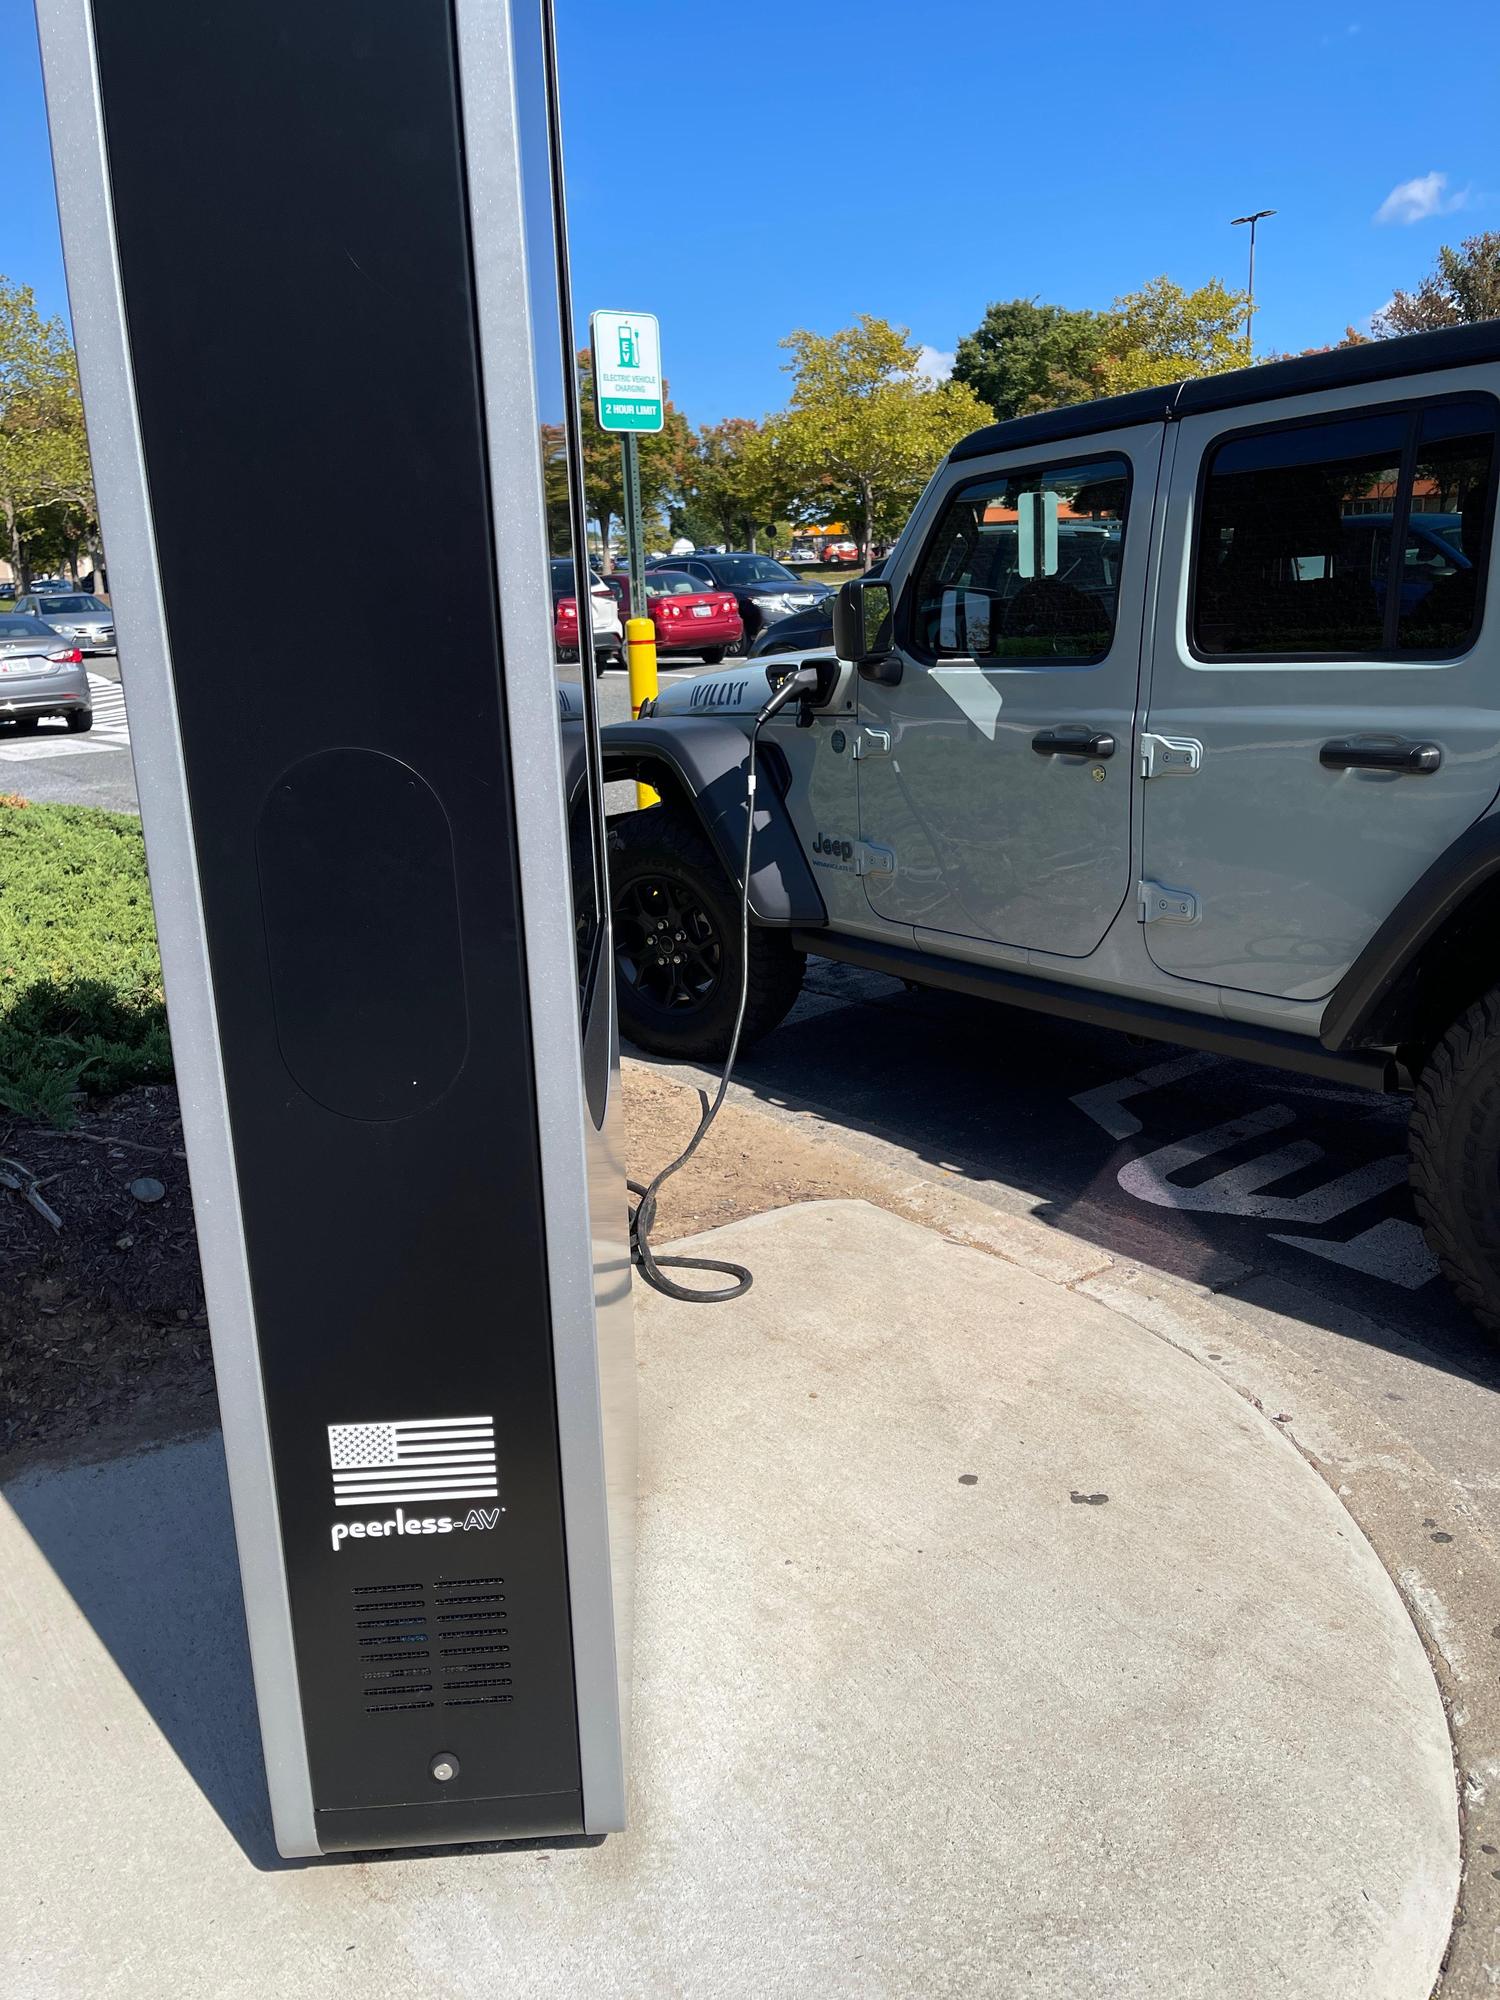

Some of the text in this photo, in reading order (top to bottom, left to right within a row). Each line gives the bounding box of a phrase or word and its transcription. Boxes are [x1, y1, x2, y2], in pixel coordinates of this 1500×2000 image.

[603, 373, 656, 384] ELECTRIC VEHICLE
[615, 384, 646, 393] CHARGING
[605, 404, 657, 416] 2 HOUR LIMIT
[689, 681, 749, 707] WILLYS
[812, 832, 853, 862] Jeep
